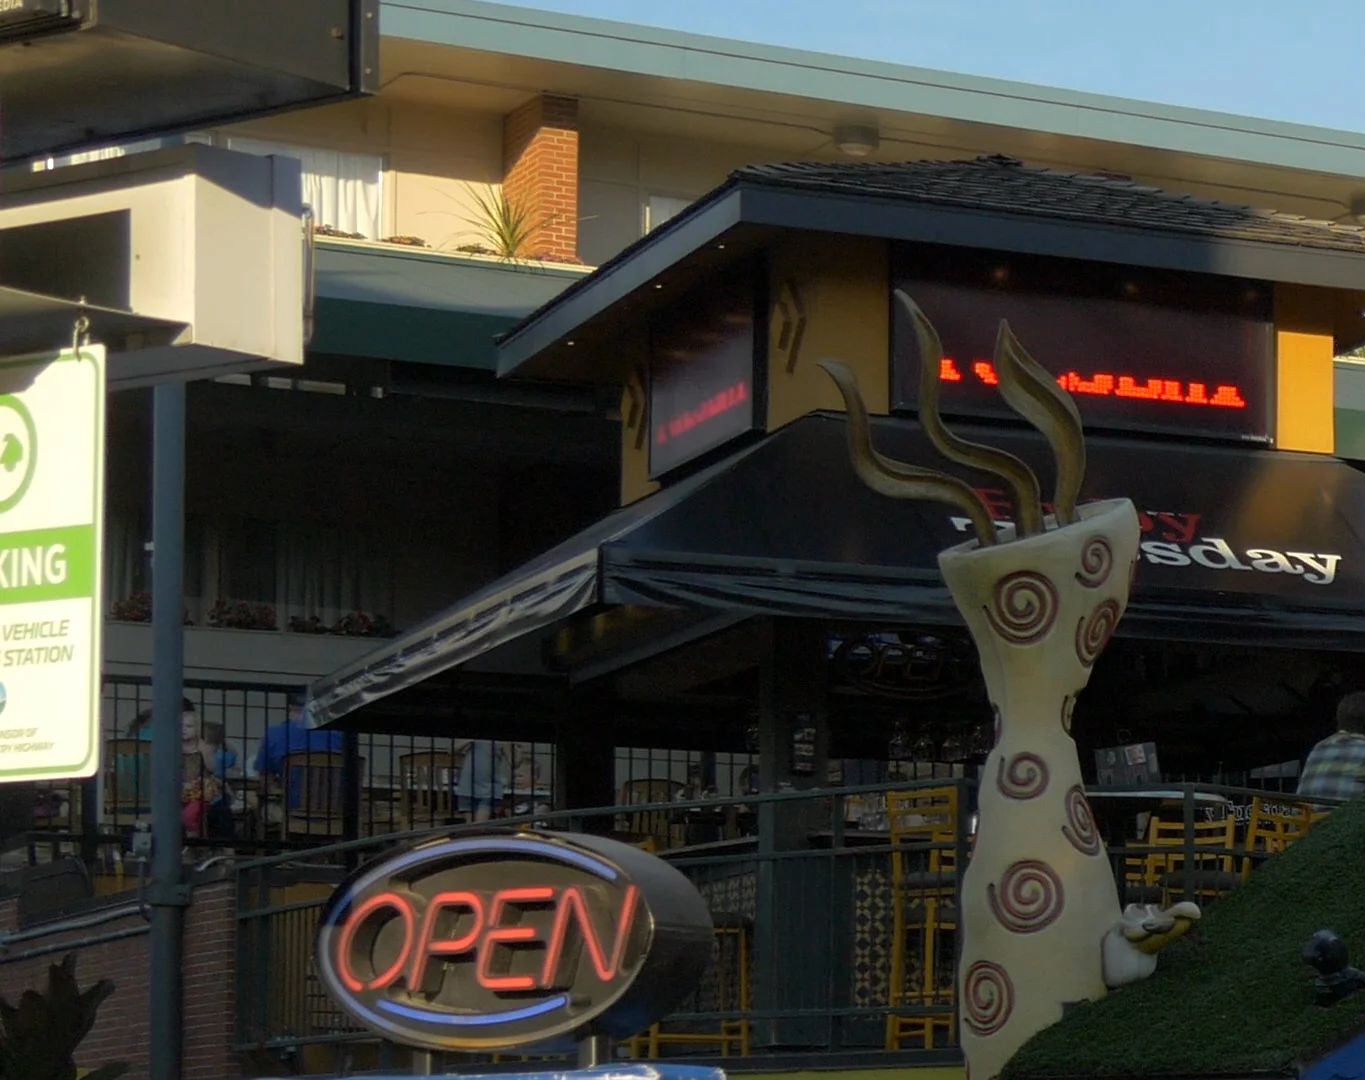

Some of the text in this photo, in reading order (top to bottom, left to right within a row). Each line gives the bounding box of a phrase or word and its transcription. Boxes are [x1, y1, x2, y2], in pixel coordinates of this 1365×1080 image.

[2, 619, 70, 641] VEHICLE
[3, 645, 74, 667] STATION
[336, 885, 640, 992] OPEN
